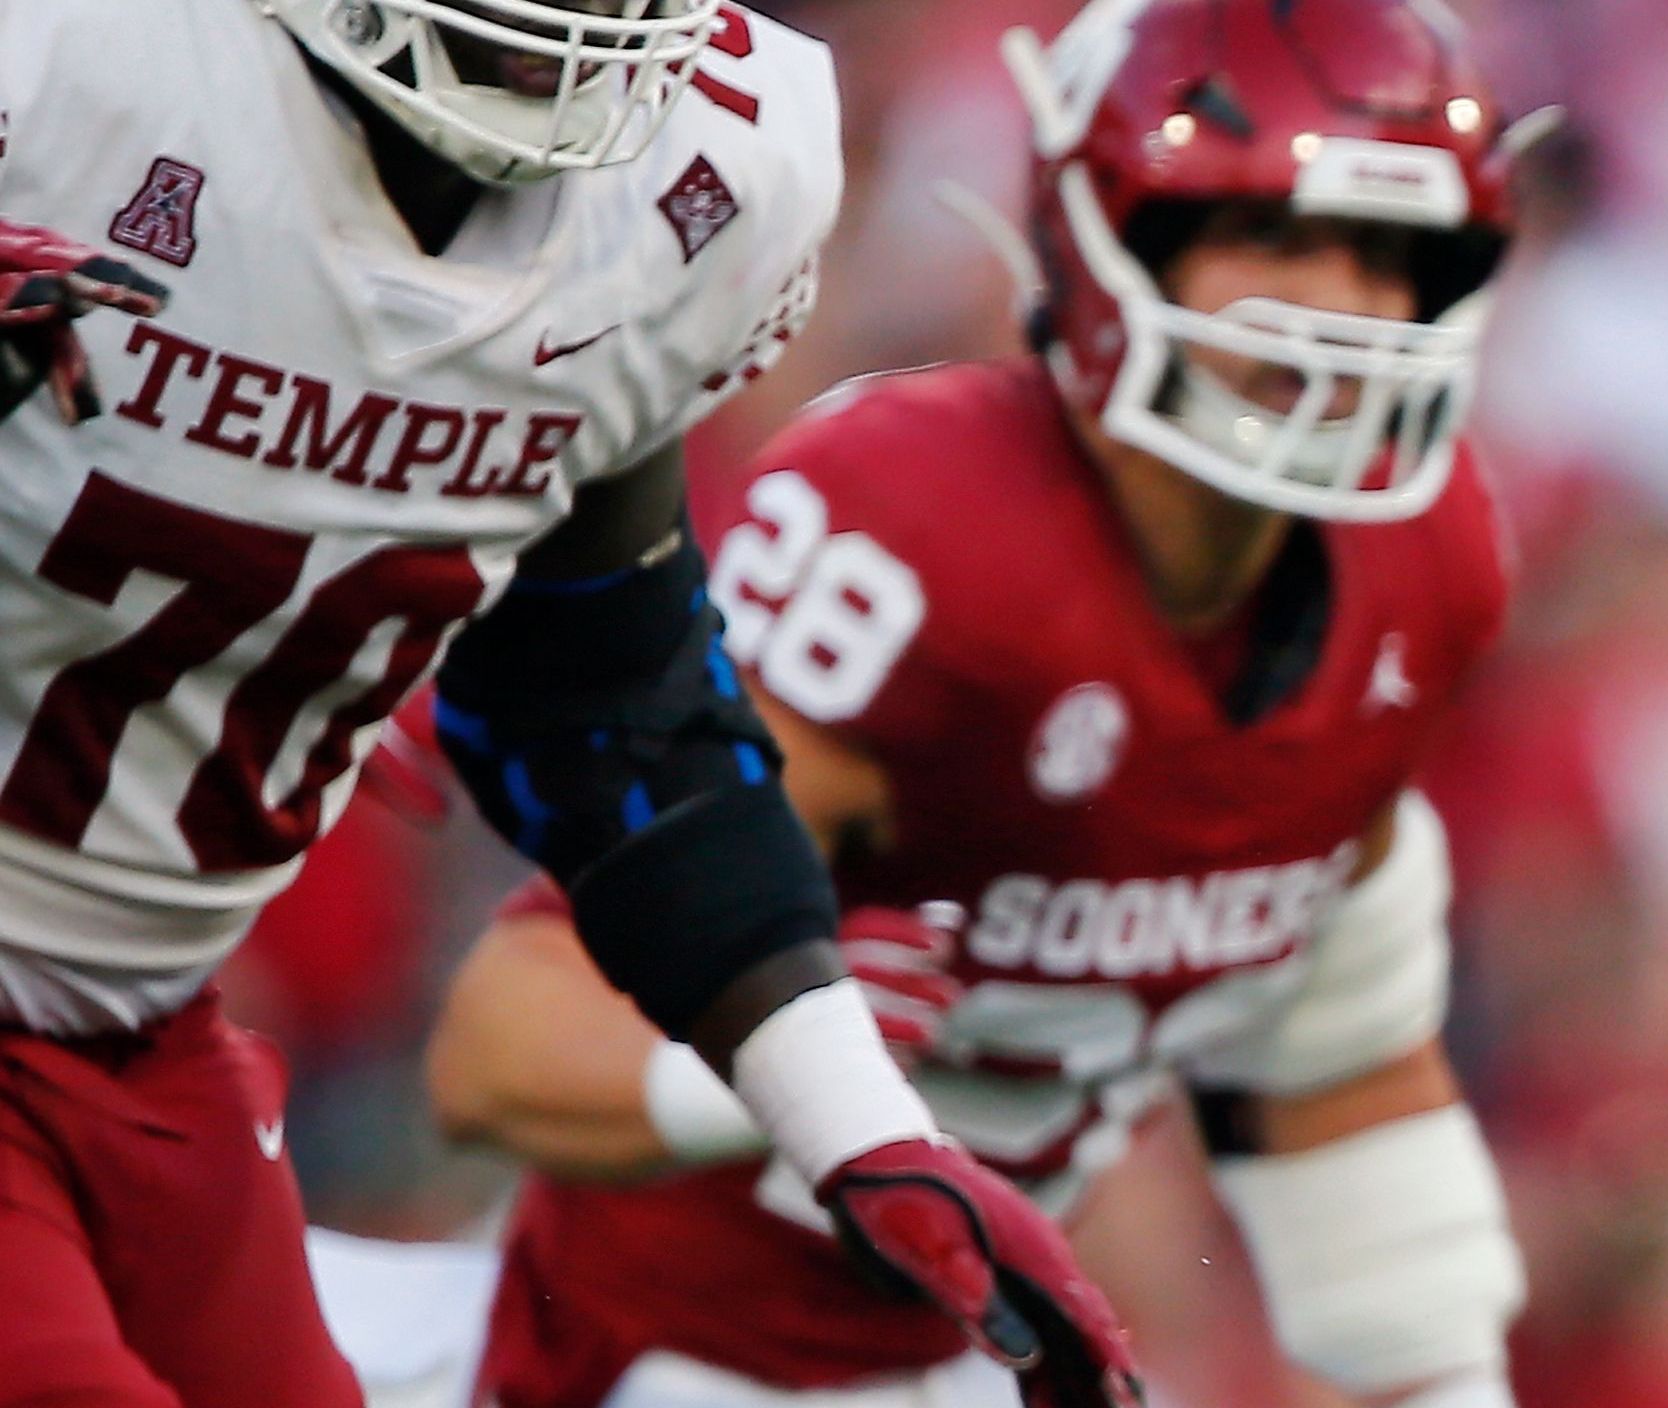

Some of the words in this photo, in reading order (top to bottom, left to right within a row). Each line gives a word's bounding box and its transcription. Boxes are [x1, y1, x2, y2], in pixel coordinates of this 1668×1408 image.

[114, 320, 586, 498] TEMPLE
[0, 468, 486, 874] 70
[709, 469, 925, 724] 28
